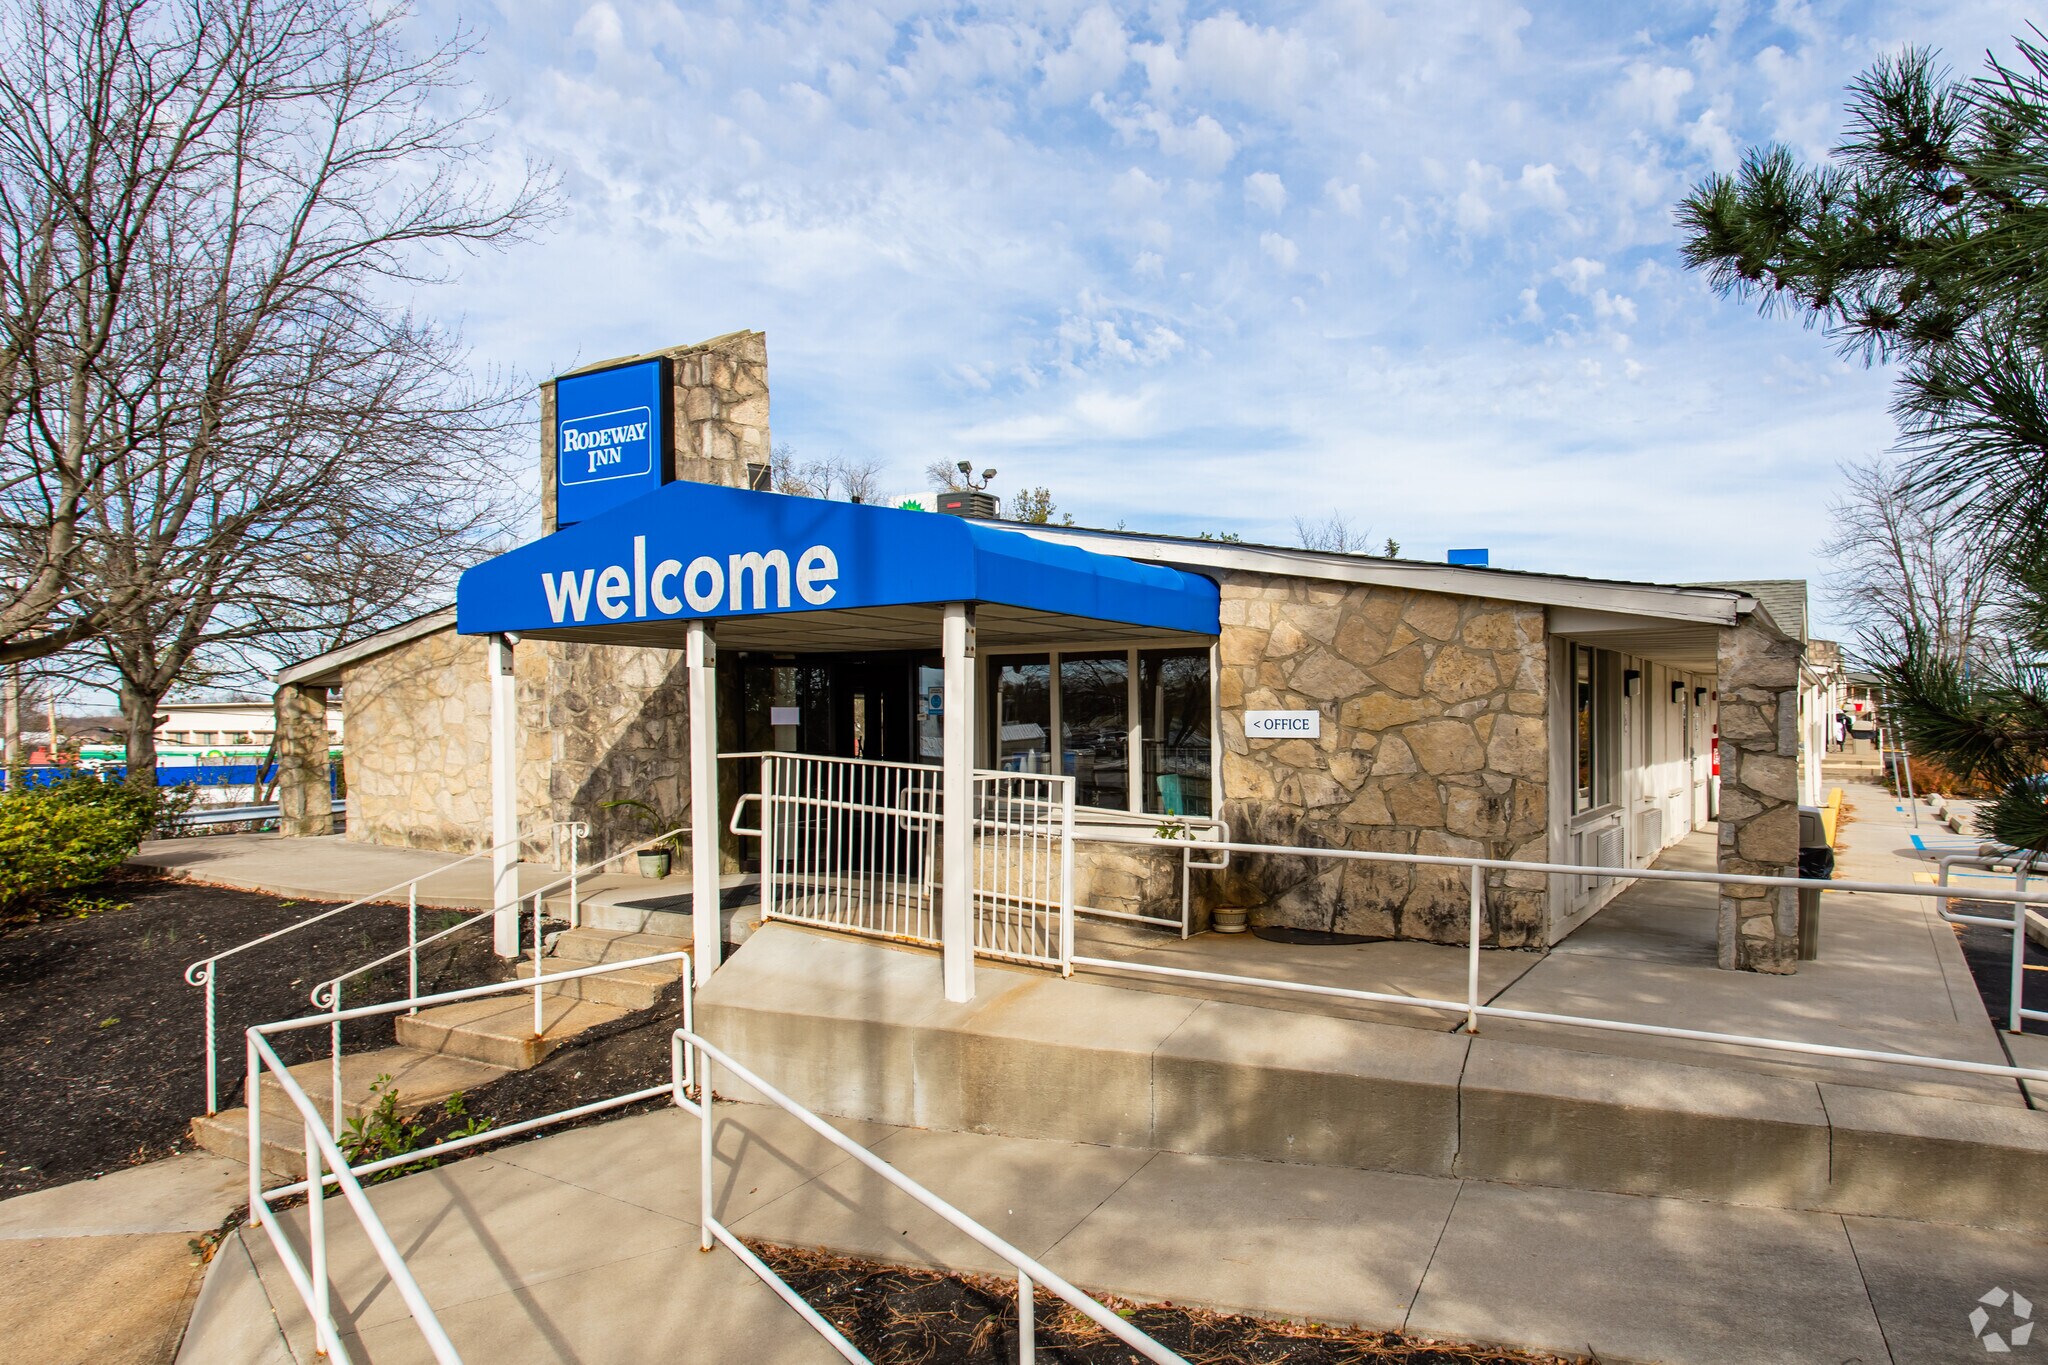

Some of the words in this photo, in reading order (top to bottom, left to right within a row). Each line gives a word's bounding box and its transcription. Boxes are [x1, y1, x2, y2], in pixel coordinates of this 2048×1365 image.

[563, 422, 648, 453] RODEWAY
[587, 446, 622, 473] INN
[541, 535, 839, 623] welcome
[1264, 718, 1310, 731] OFFICE
